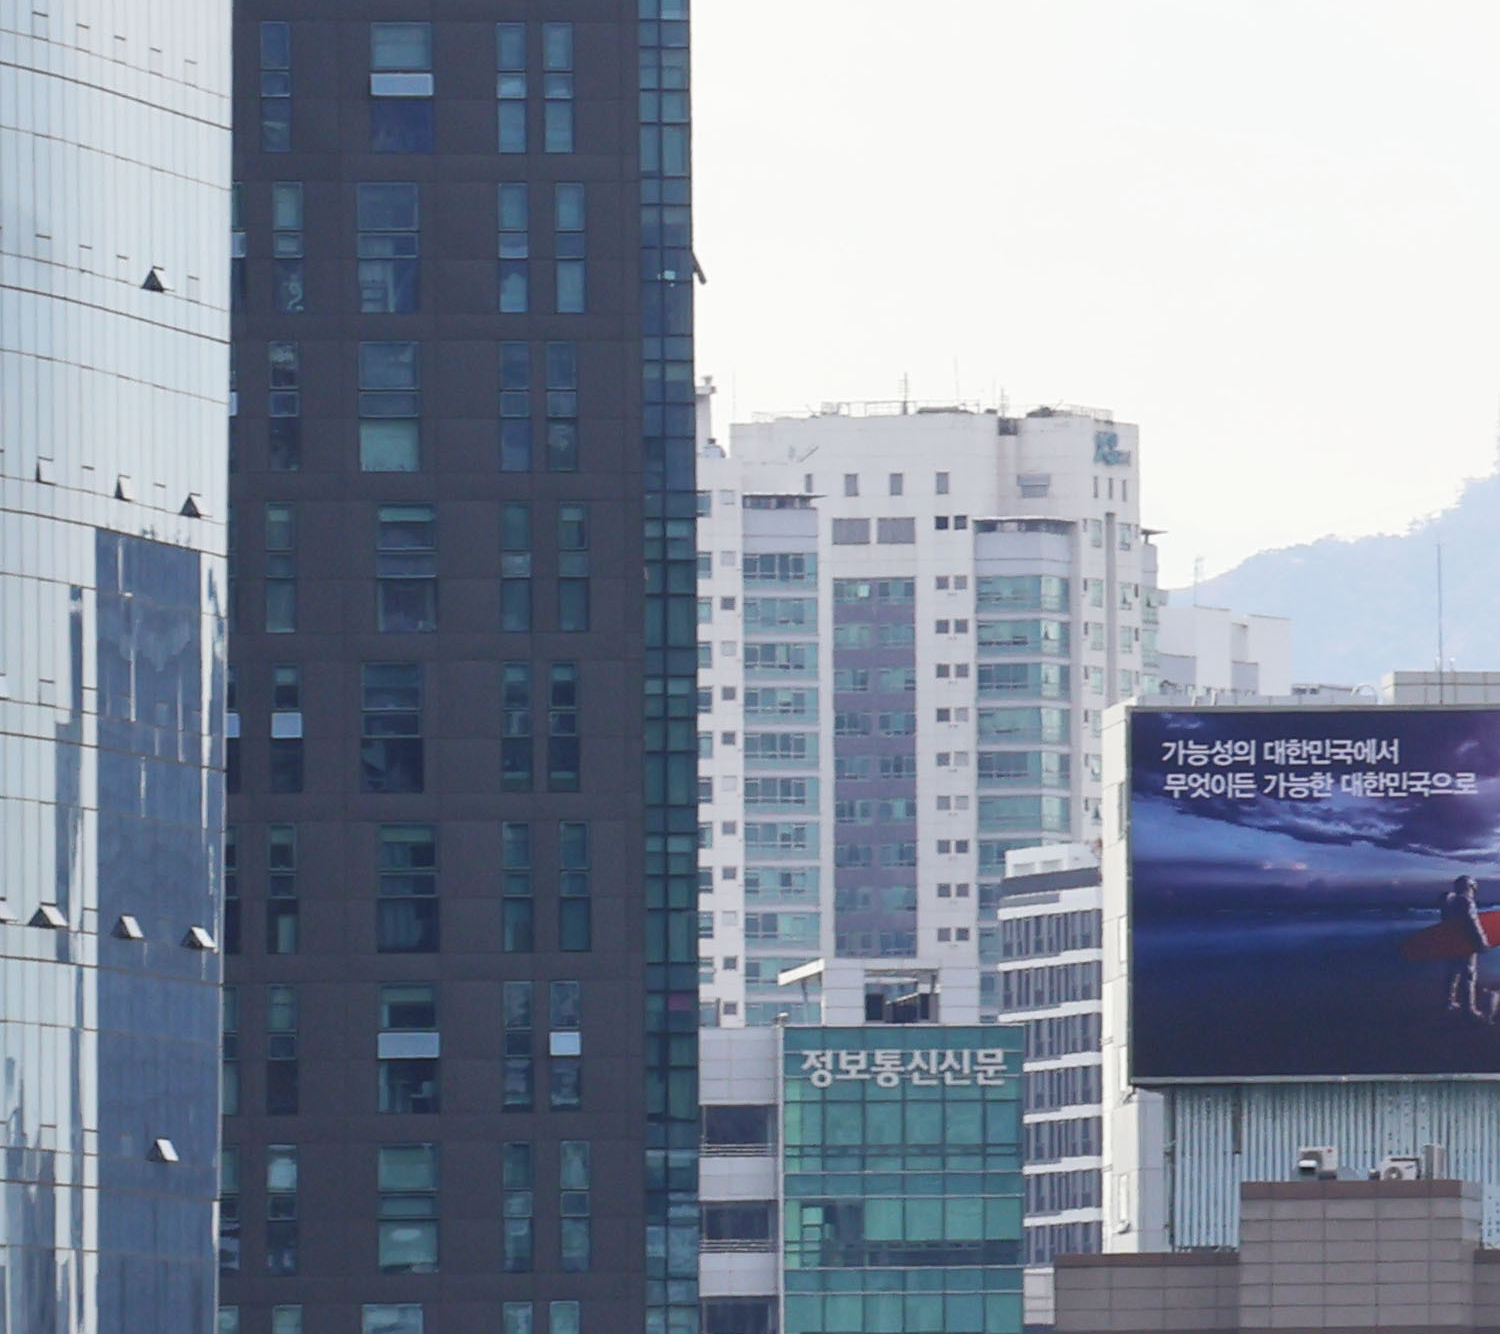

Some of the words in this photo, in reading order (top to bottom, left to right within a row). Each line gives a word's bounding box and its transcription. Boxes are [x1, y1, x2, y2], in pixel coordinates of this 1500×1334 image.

[1161, 740, 1257, 766] 가능성의
[1263, 739, 1400, 766] 대한민국에서
[1163, 772, 1257, 799] 무엇이든
[1263, 772, 1333, 798] 가능한
[1340, 771, 1478, 797] 대한민국으로
[801, 1049, 1009, 1088] 정보통신신문
